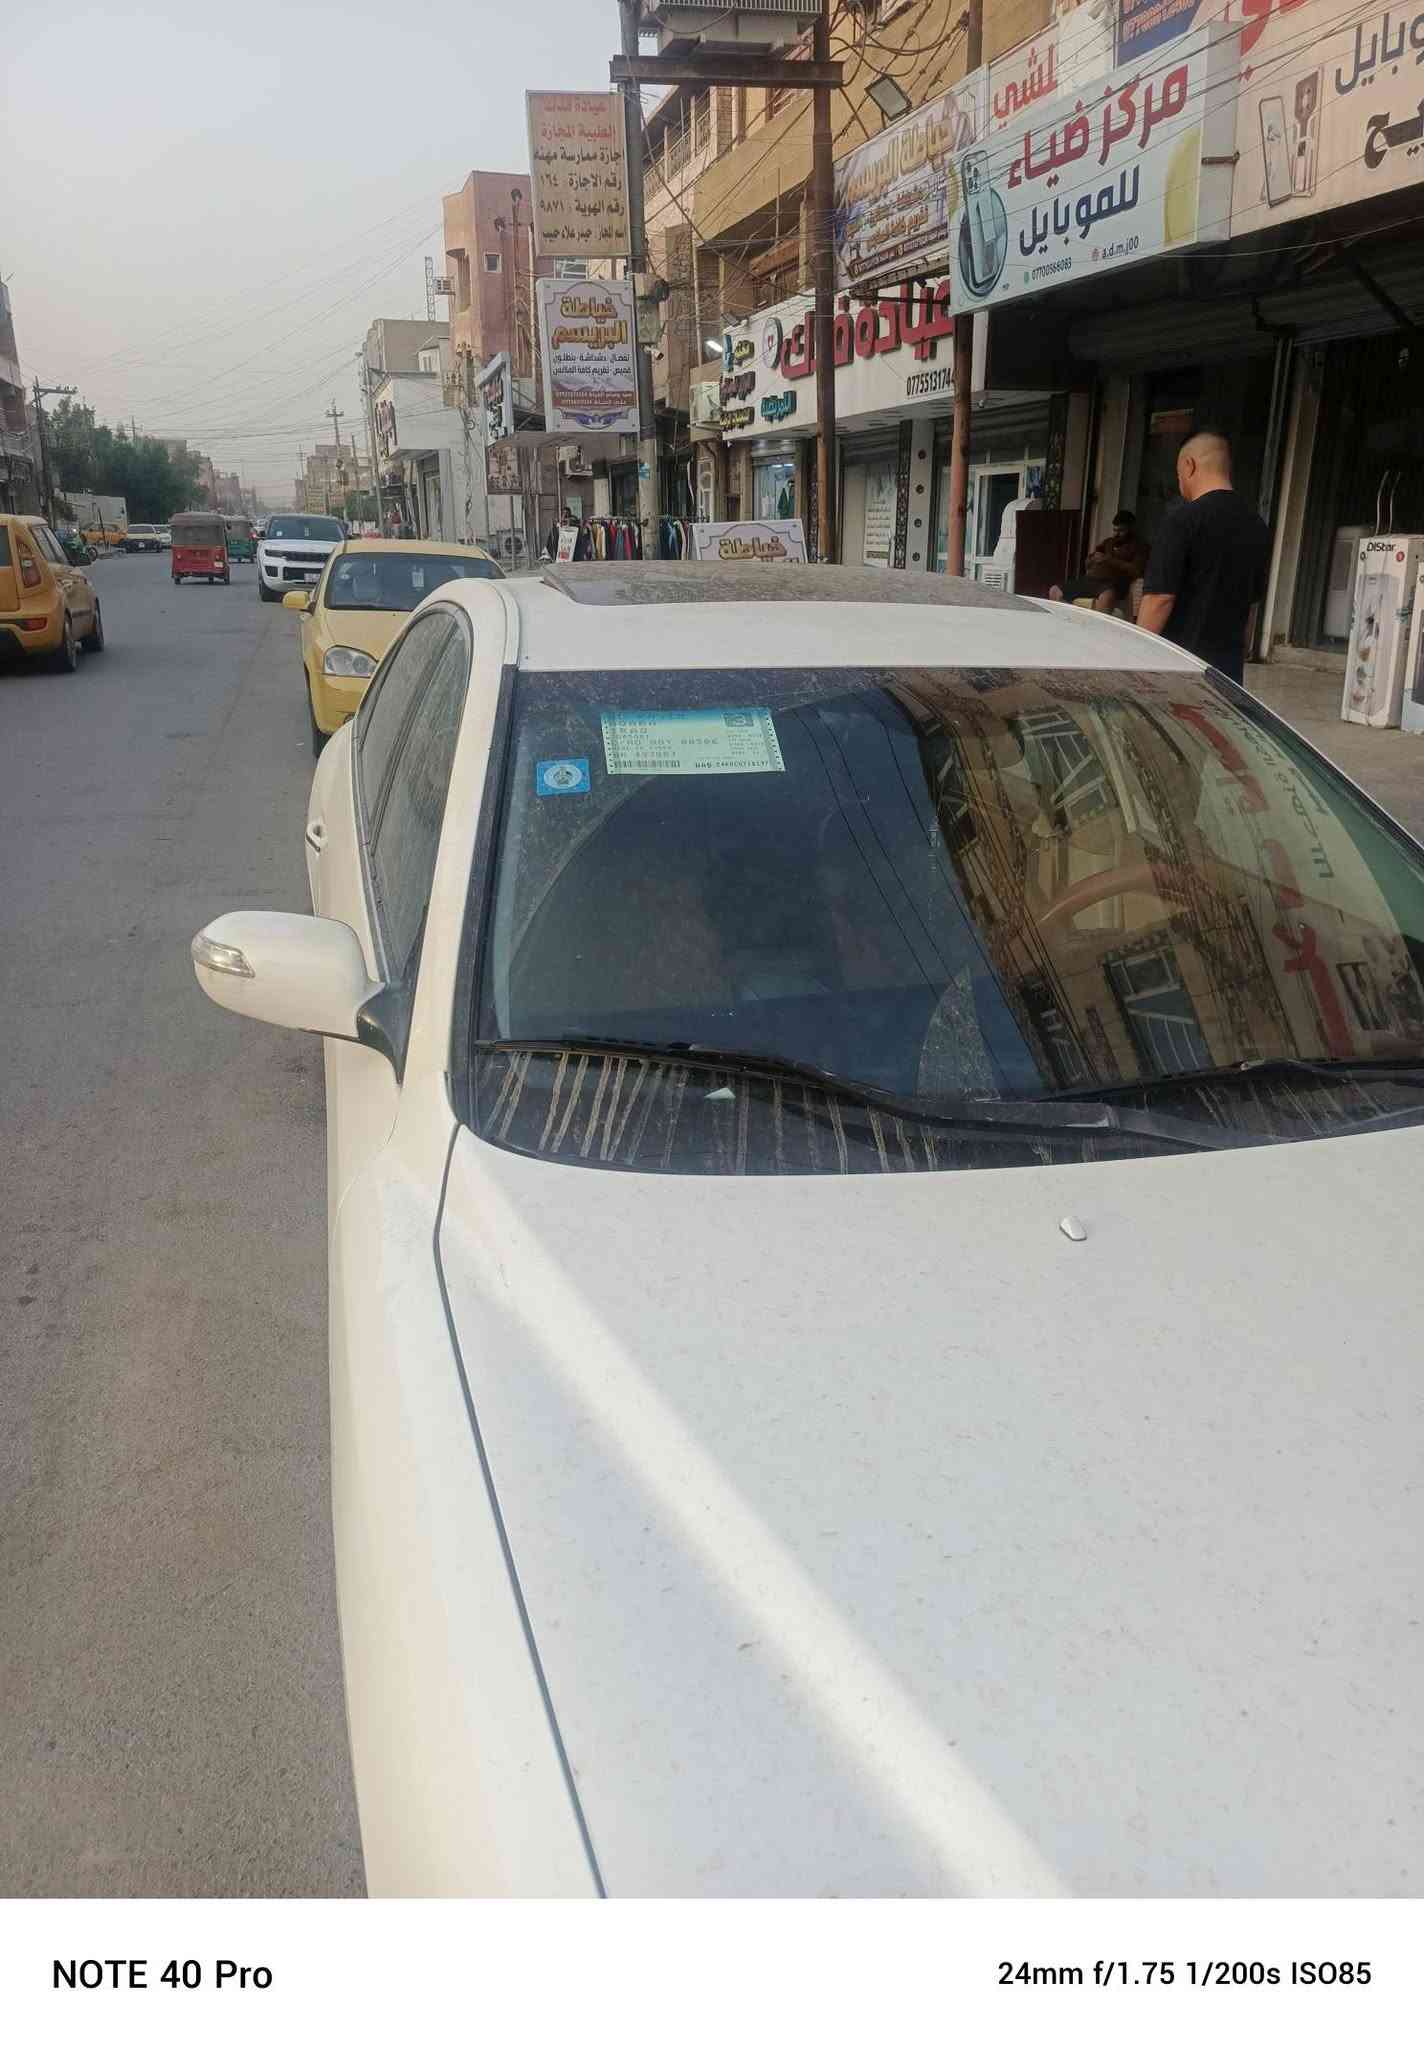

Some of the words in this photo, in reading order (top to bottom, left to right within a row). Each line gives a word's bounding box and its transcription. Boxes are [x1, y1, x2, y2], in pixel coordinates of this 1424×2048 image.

[1007, 99, 1090, 190] ضياء
[1098, 63, 1189, 167] مركز
[1018, 163, 1141, 257] للموبايل
[551, 319, 628, 351] البريسم
[560, 294, 619, 325] خياطة
[780, 294, 854, 381] فك
